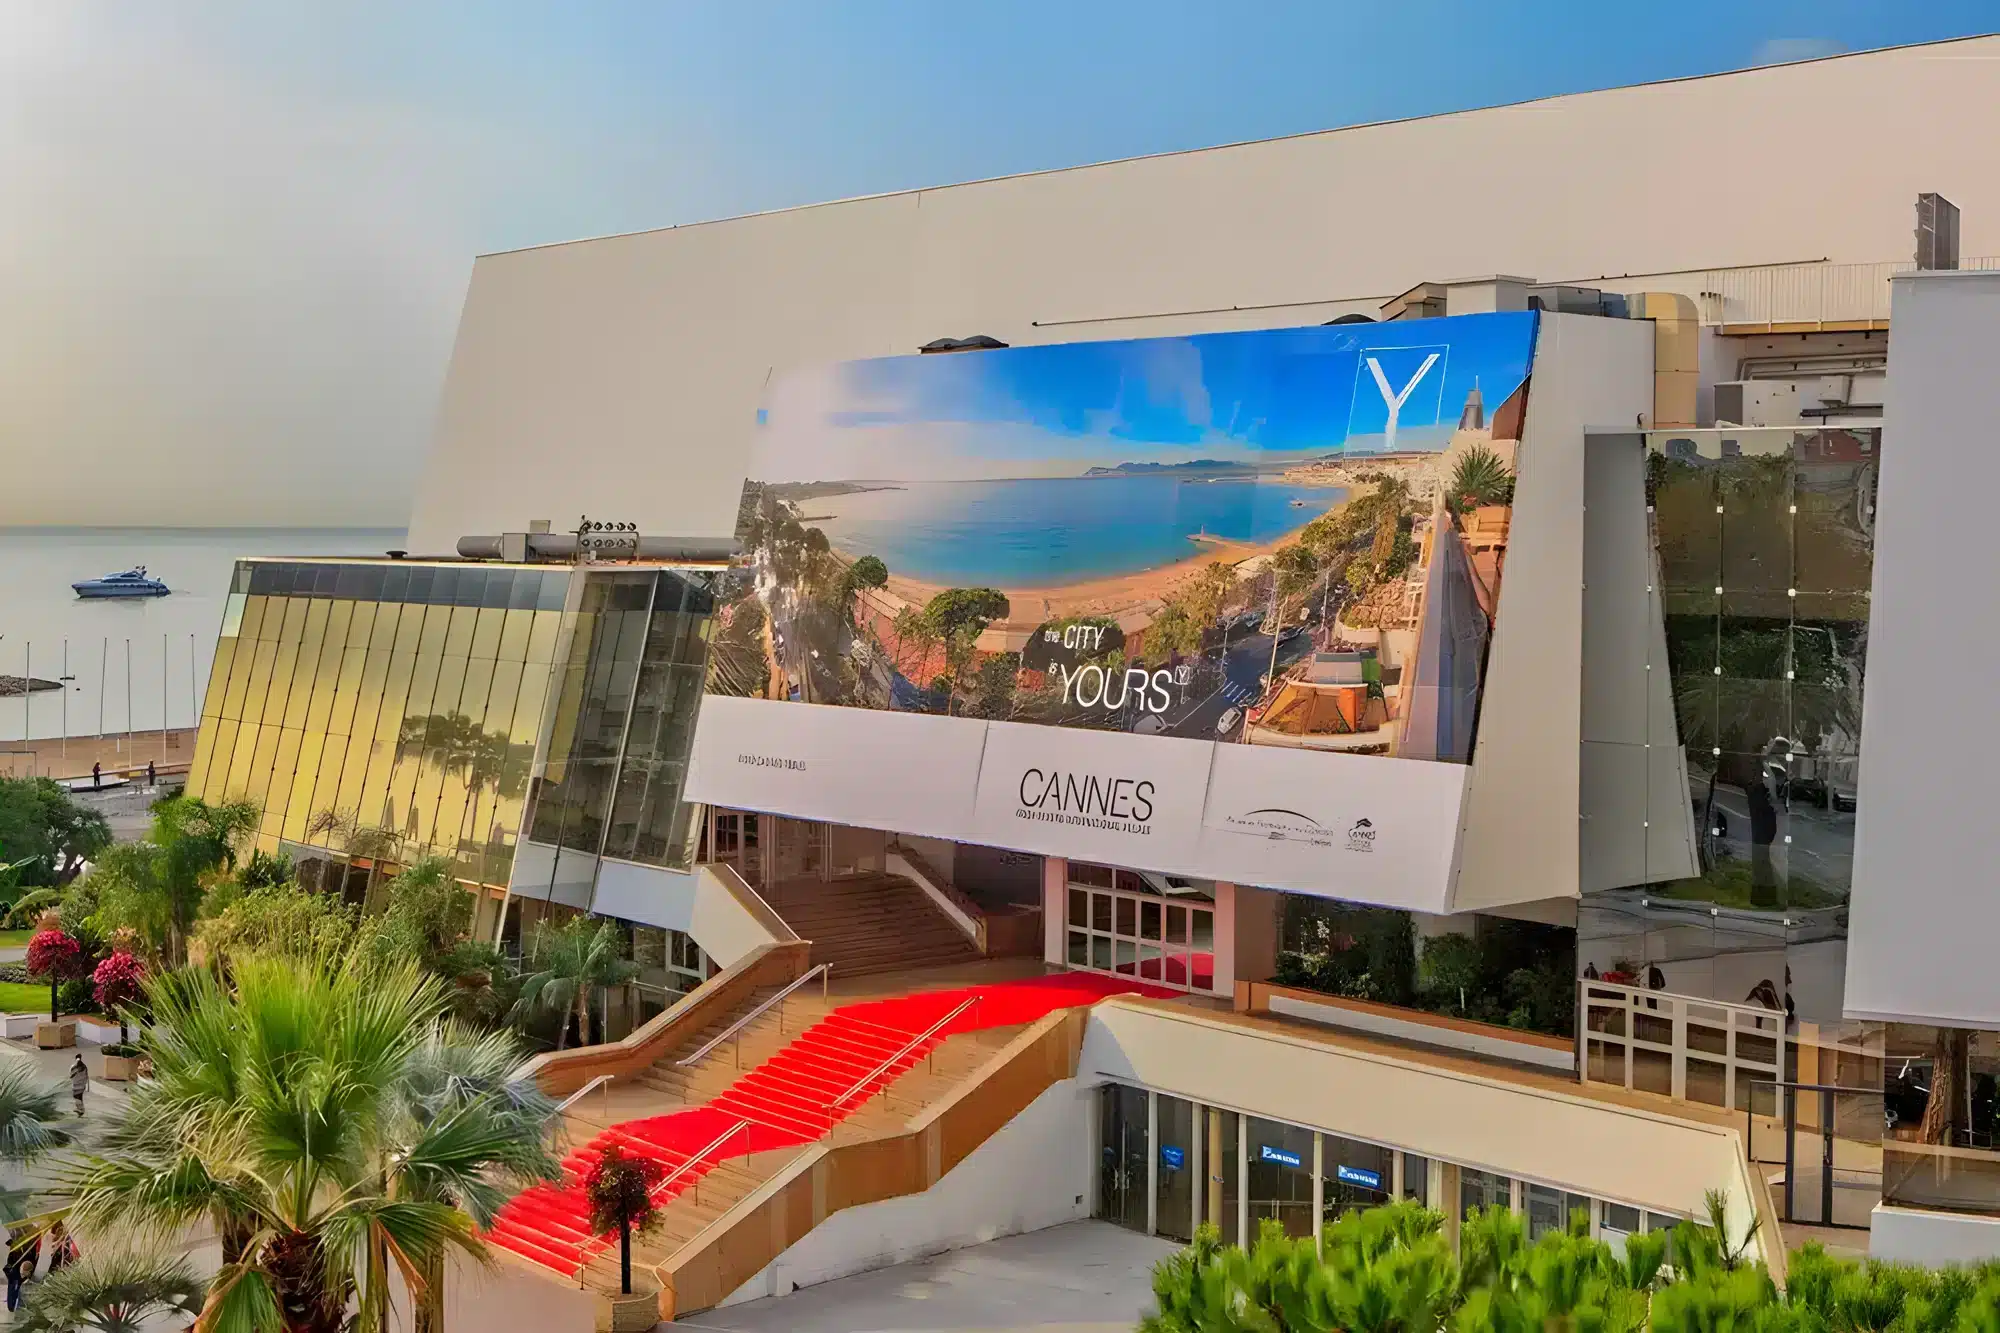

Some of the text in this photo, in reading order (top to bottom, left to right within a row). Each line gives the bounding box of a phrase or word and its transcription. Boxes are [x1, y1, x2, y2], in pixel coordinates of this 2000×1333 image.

[1366, 353, 1440, 450] Y
[1063, 624, 1106, 650] CITY
[1060, 663, 1173, 713] YOURS
[1020, 768, 1156, 822] CANNES
